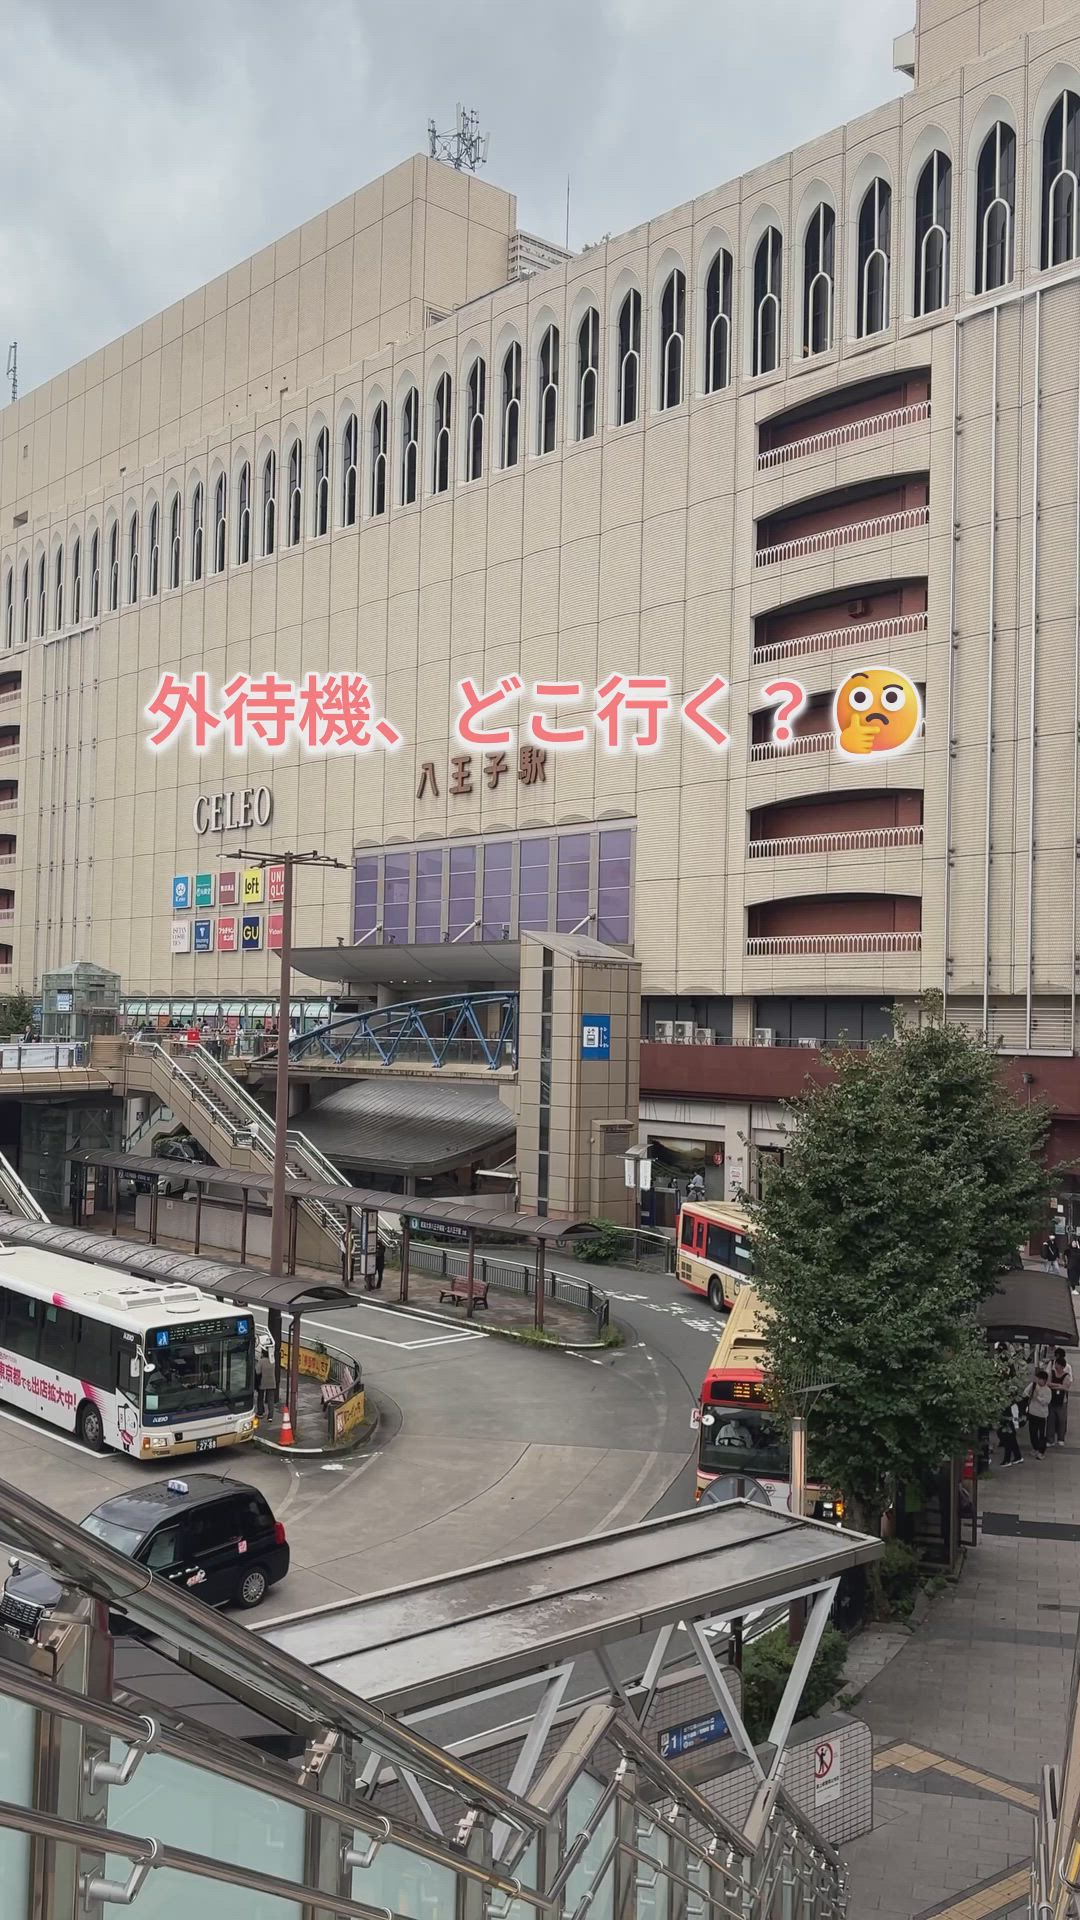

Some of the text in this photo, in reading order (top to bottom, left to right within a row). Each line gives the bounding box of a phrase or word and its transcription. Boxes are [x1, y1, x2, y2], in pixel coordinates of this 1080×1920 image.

[416, 746, 546, 798] 八王子駅
[192, 785, 273, 834] CELEO
[245, 878, 259, 894] Loft
[243, 926, 259, 940] GU
[671, 1735, 677, 1749] 1
